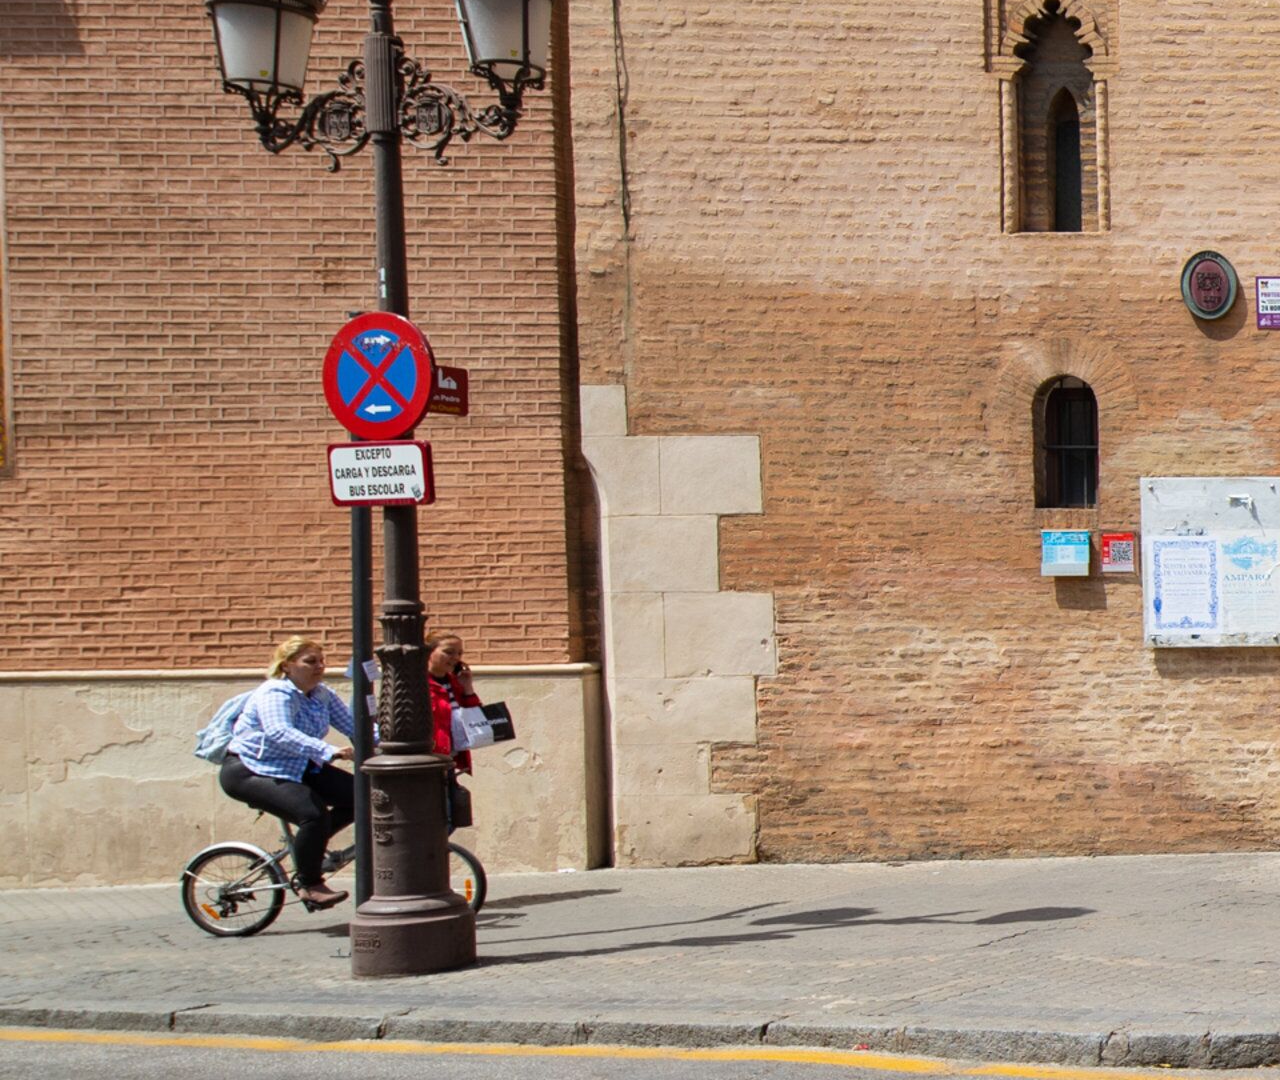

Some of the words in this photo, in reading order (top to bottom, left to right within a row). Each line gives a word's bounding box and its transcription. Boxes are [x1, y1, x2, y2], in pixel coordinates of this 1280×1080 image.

[355, 447, 391, 460] EXCEPTO
[335, 467, 363, 480] CARGA
[364, 466, 370, 478] Y
[371, 464, 416, 478] DESCARGA
[349, 485, 366, 497] BUS
[367, 483, 405, 496] ESCOLAR
